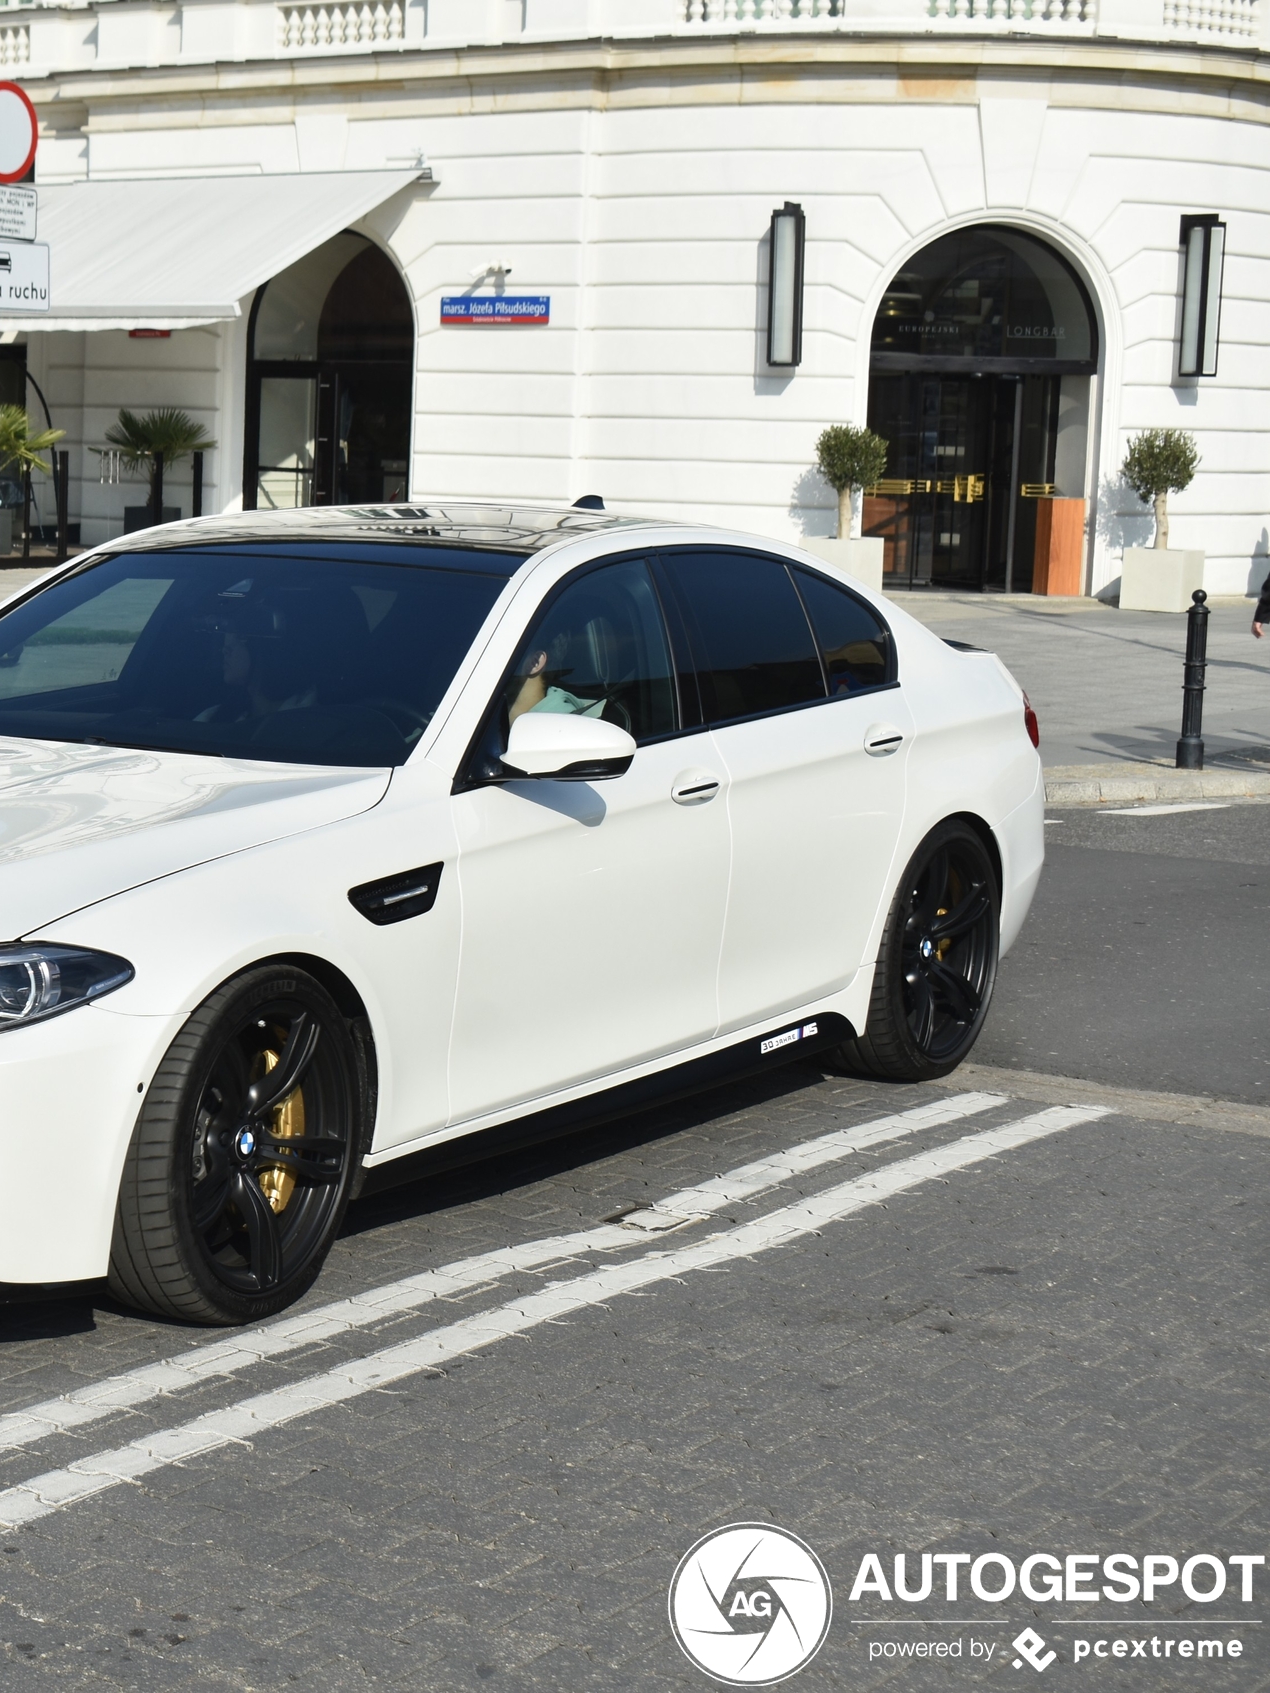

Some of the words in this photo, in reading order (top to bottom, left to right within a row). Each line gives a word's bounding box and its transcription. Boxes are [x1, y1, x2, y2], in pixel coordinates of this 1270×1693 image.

[9, 281, 47, 300] ruchu
[443, 303, 467, 314] marsz.
[468, 301, 493, 315] Józefa
[494, 301, 546, 317] Piłsudskiego
[898, 325, 959, 334] EUROPEJSKI
[1006, 324, 1067, 340] LONGBAR
